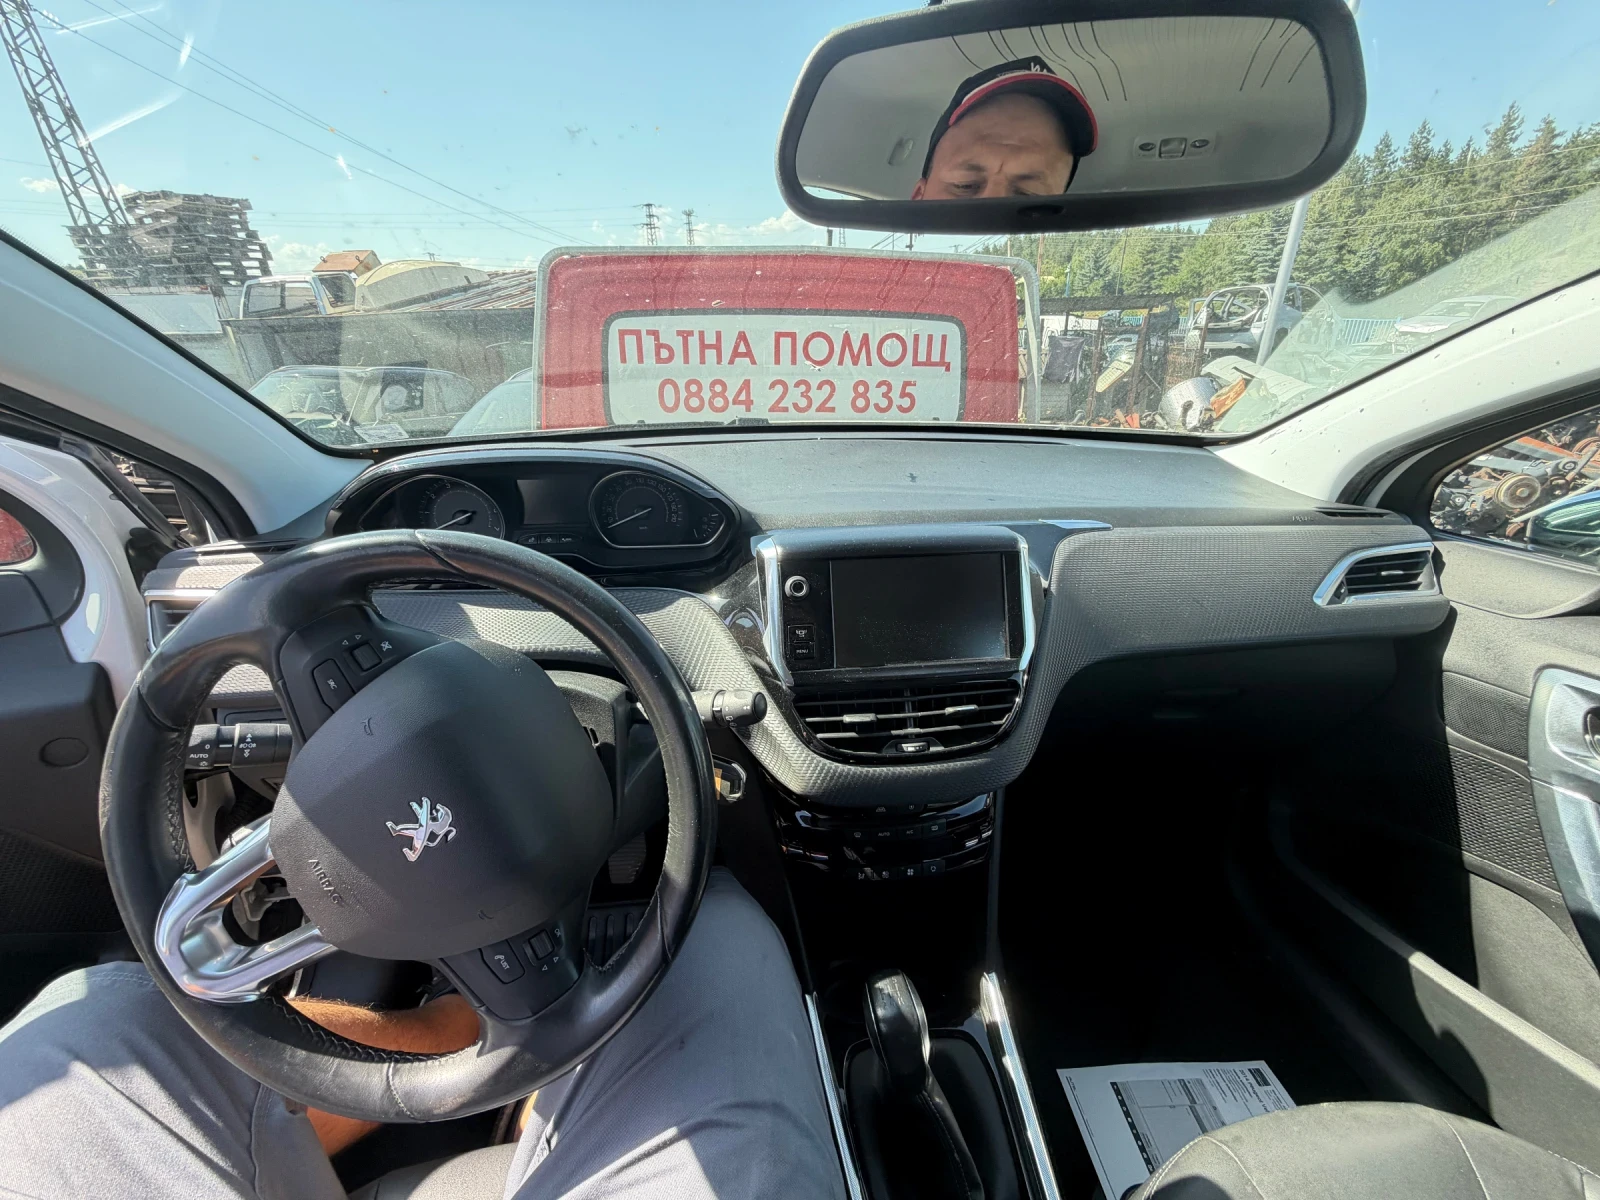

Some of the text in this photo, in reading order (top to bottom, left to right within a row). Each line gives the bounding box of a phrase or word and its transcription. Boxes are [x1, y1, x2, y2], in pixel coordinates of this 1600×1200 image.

[618, 328, 951, 372] ПЪТНА ПОМОЩ
[658, 379, 917, 413] 0884 232 835
[307, 859, 342, 905] AIRBAG
